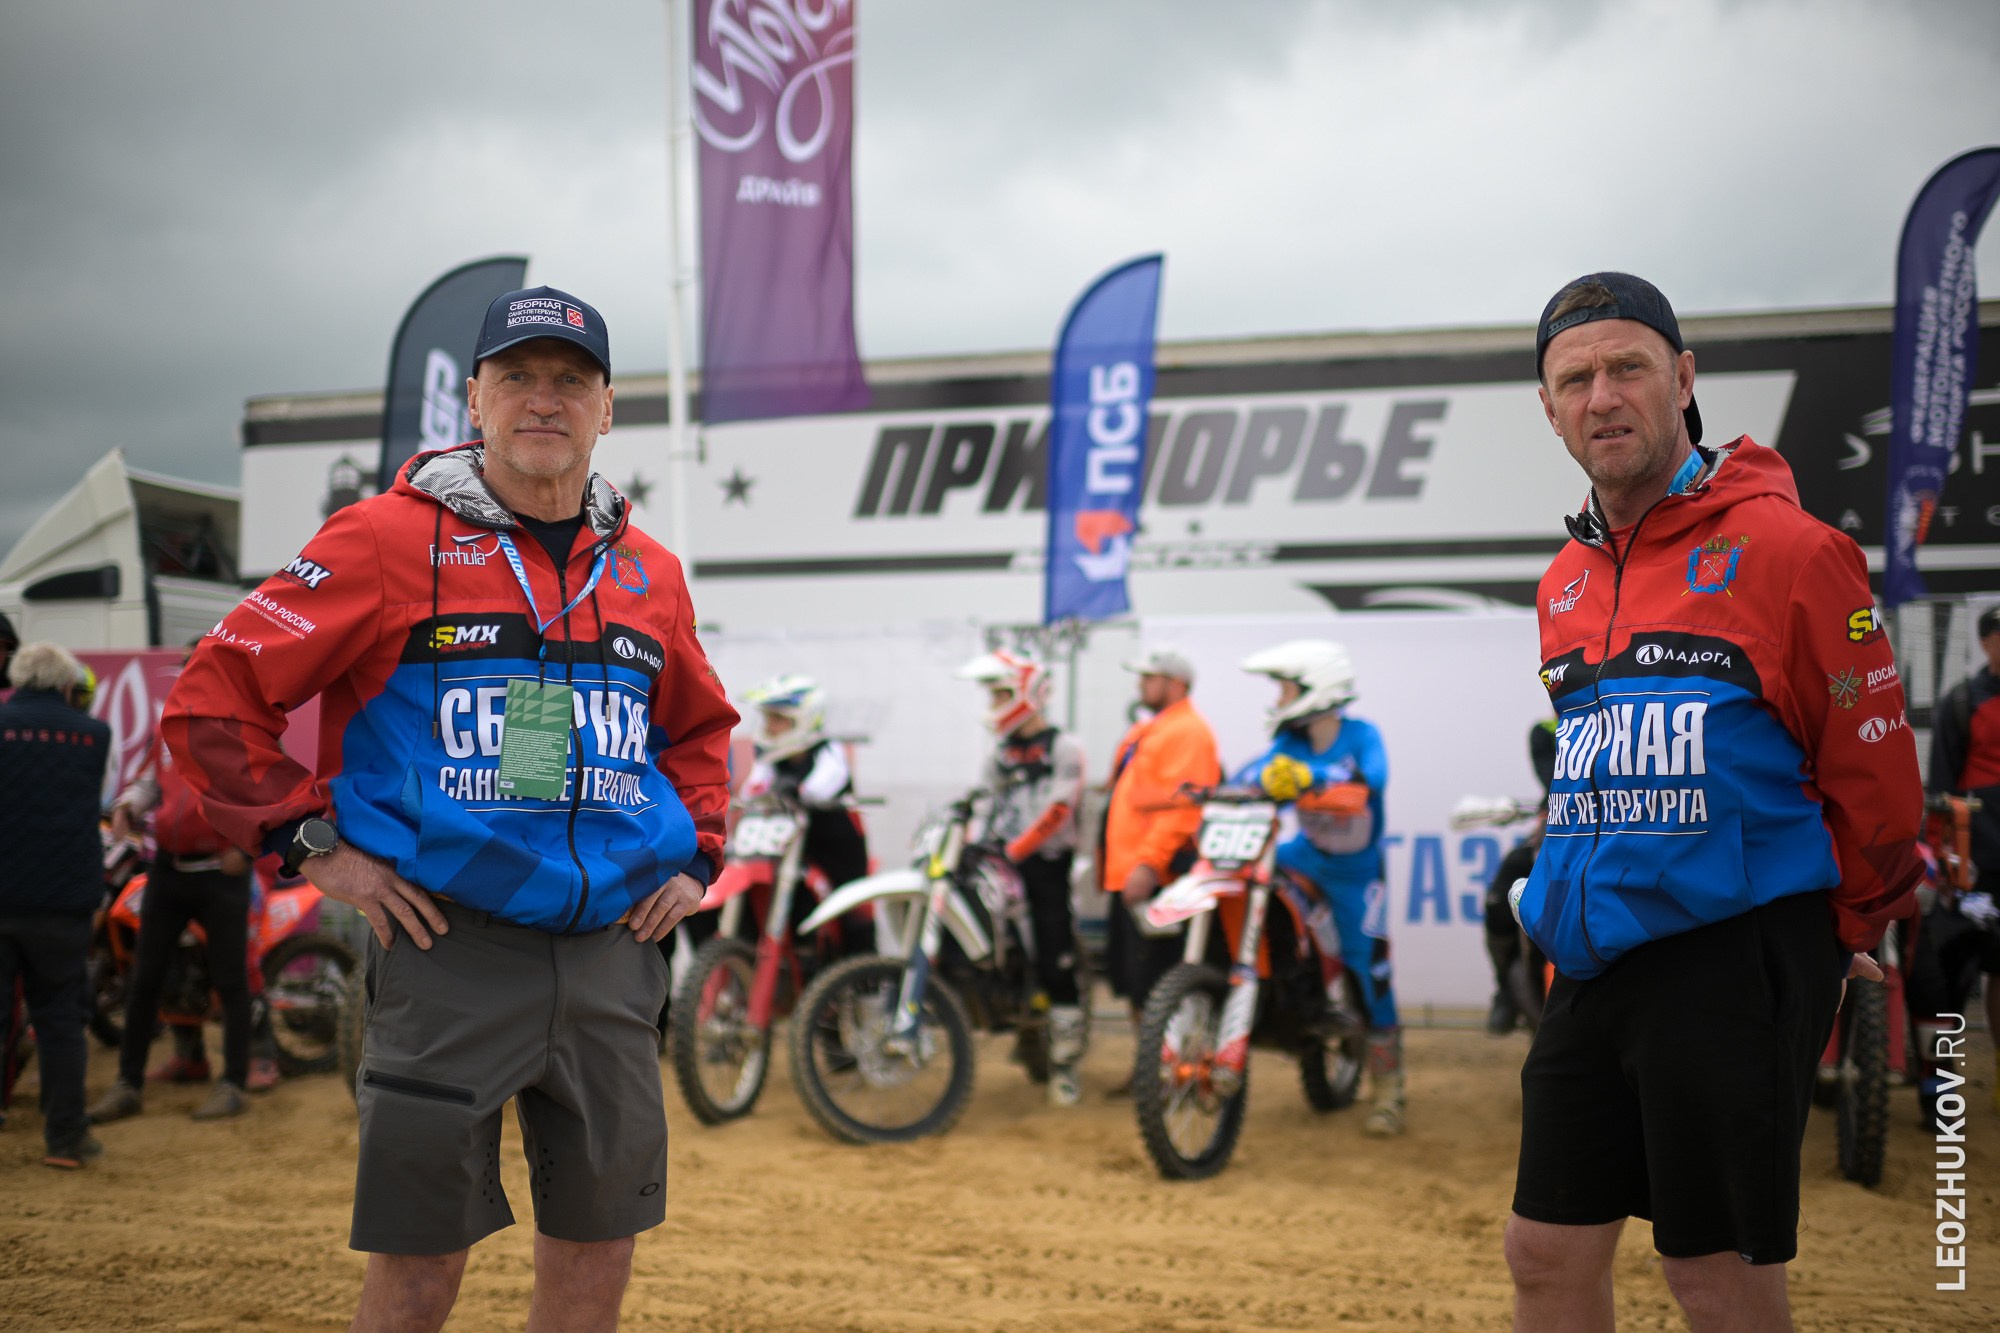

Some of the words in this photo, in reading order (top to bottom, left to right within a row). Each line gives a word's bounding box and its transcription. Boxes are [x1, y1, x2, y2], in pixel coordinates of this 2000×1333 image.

[736, 175, 822, 207] ДРАЙВ
[507, 315, 563, 326] МОТОКРОСС
[509, 300, 562, 311] СБОРНАЯ
[1910, 285, 1939, 444] ФЕДЕРАЦИЯ
[1087, 361, 1141, 495] ПСБ
[853, 399, 1449, 518] ПРИОРЬЕ
[282, 556, 331, 589] MX
[274, 605, 316, 634] РОССИИ
[429, 625, 500, 649] SMX
[1664, 654, 1732, 668] ЛАДОГА
